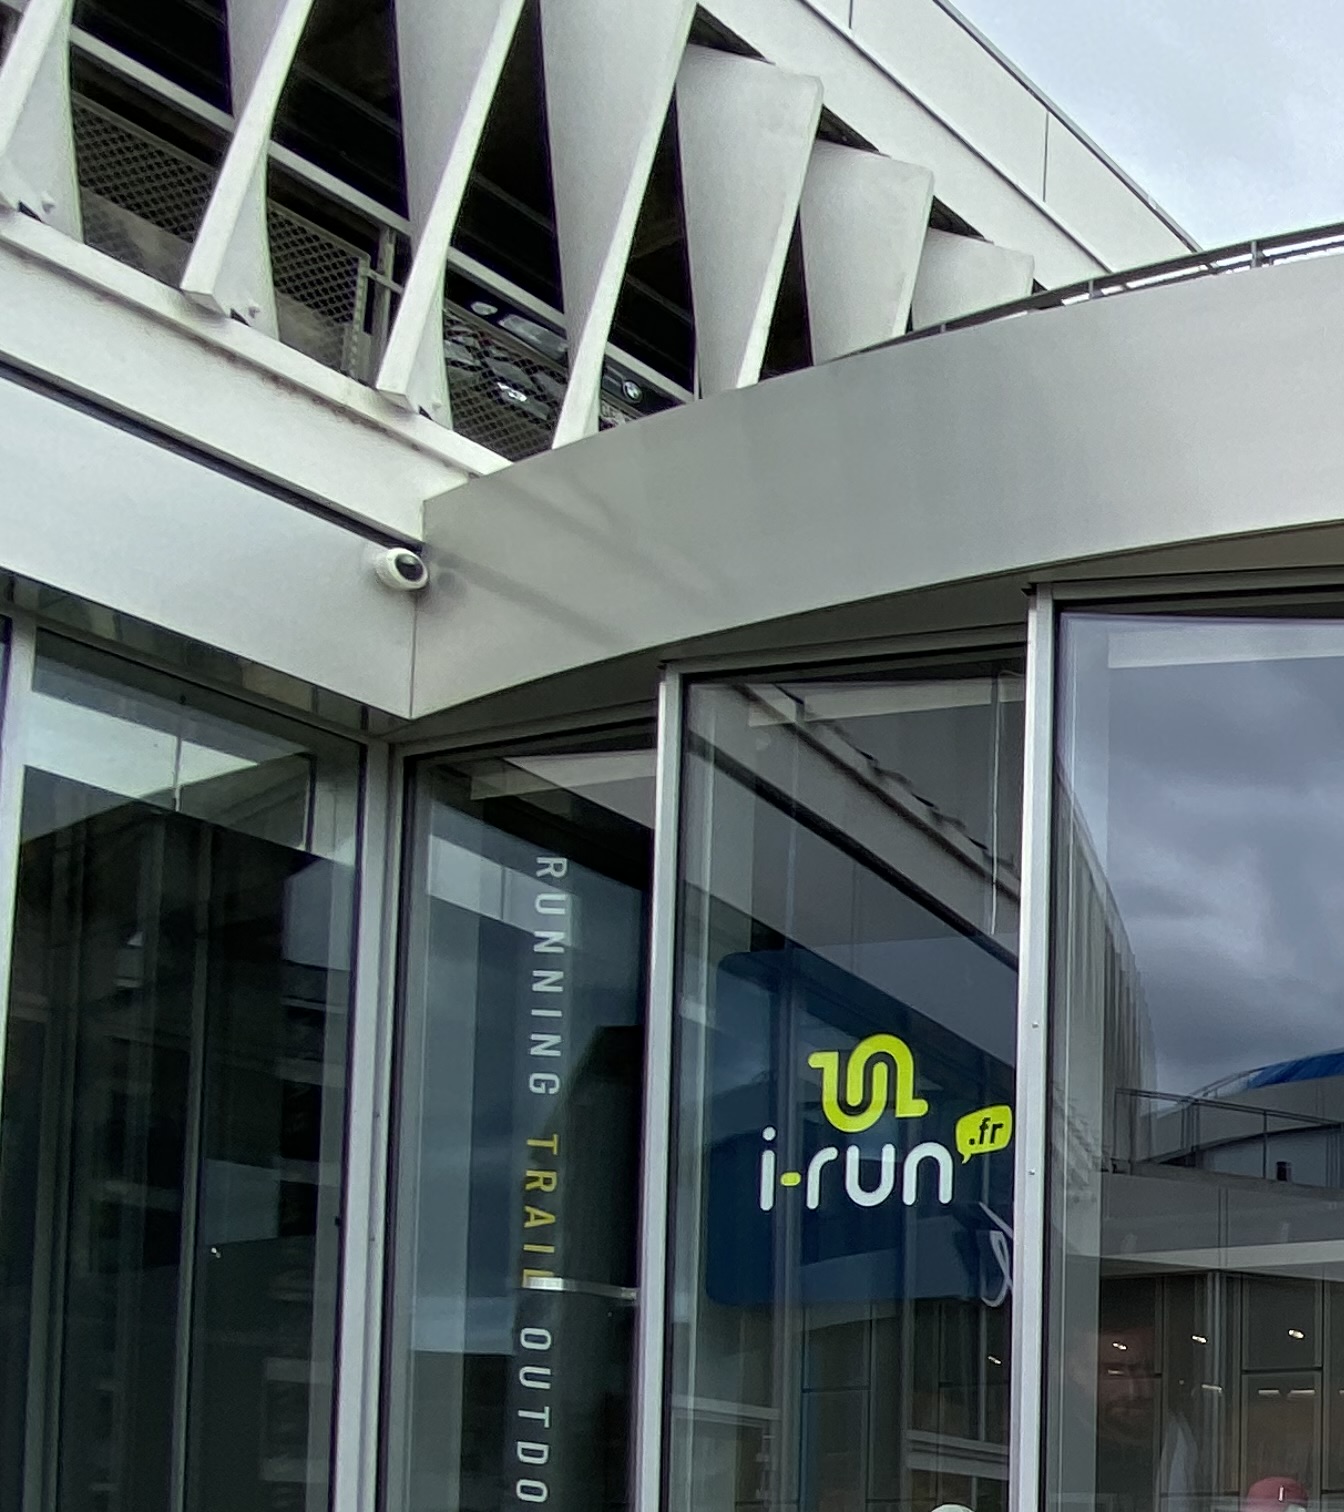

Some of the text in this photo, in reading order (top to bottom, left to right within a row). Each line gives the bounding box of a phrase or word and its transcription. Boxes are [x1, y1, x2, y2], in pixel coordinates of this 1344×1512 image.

[528, 855, 568, 1096] RUNNING
[759, 1125, 954, 1212] i-run
[968, 1117, 1004, 1146] .fr
[521, 1133, 560, 1288] TRAIL
